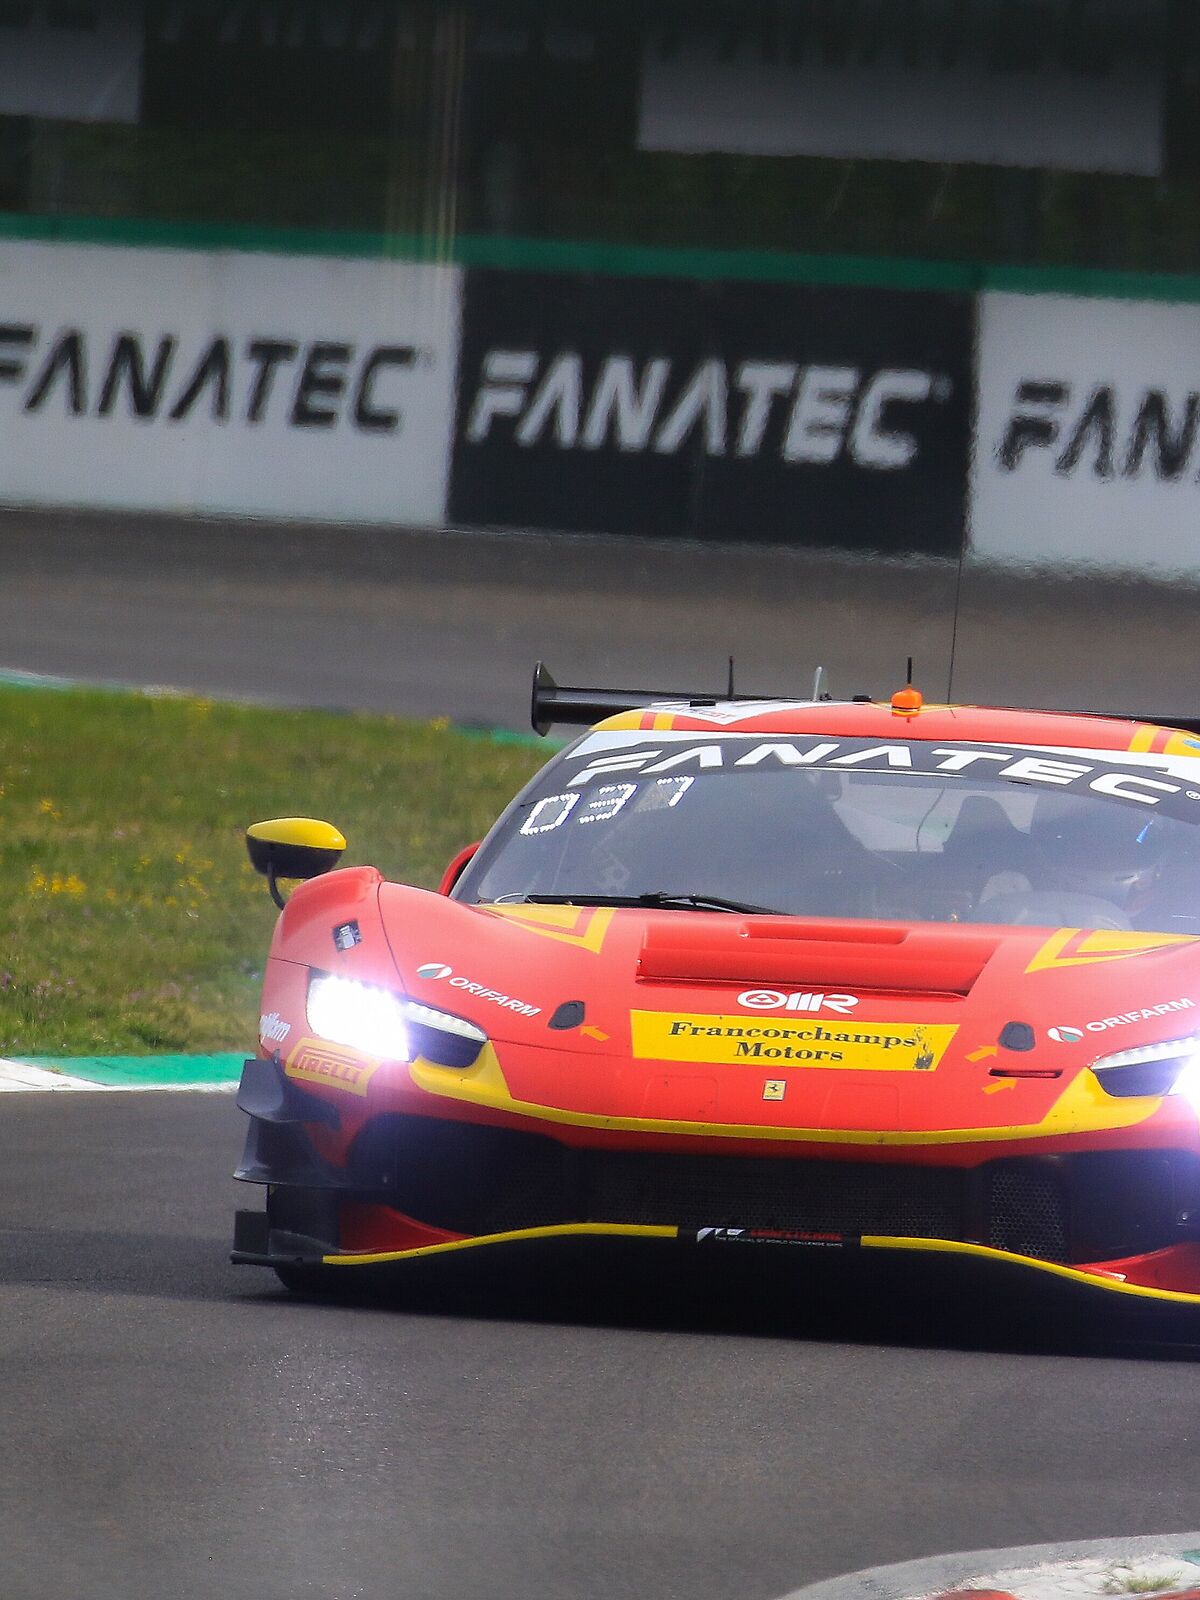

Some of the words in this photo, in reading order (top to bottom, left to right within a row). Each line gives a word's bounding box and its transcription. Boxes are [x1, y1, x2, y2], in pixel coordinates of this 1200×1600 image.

[466, 350, 932, 469] FANATEC
[566, 743, 1182, 805] FANATEC
[519, 775, 695, 835] 037
[449, 976, 542, 1017] ORIFARM
[1086, 997, 1196, 1033] ORIFARM
[667, 1021, 918, 1049] Francorchamps
[734, 1042, 843, 1062] Motors
